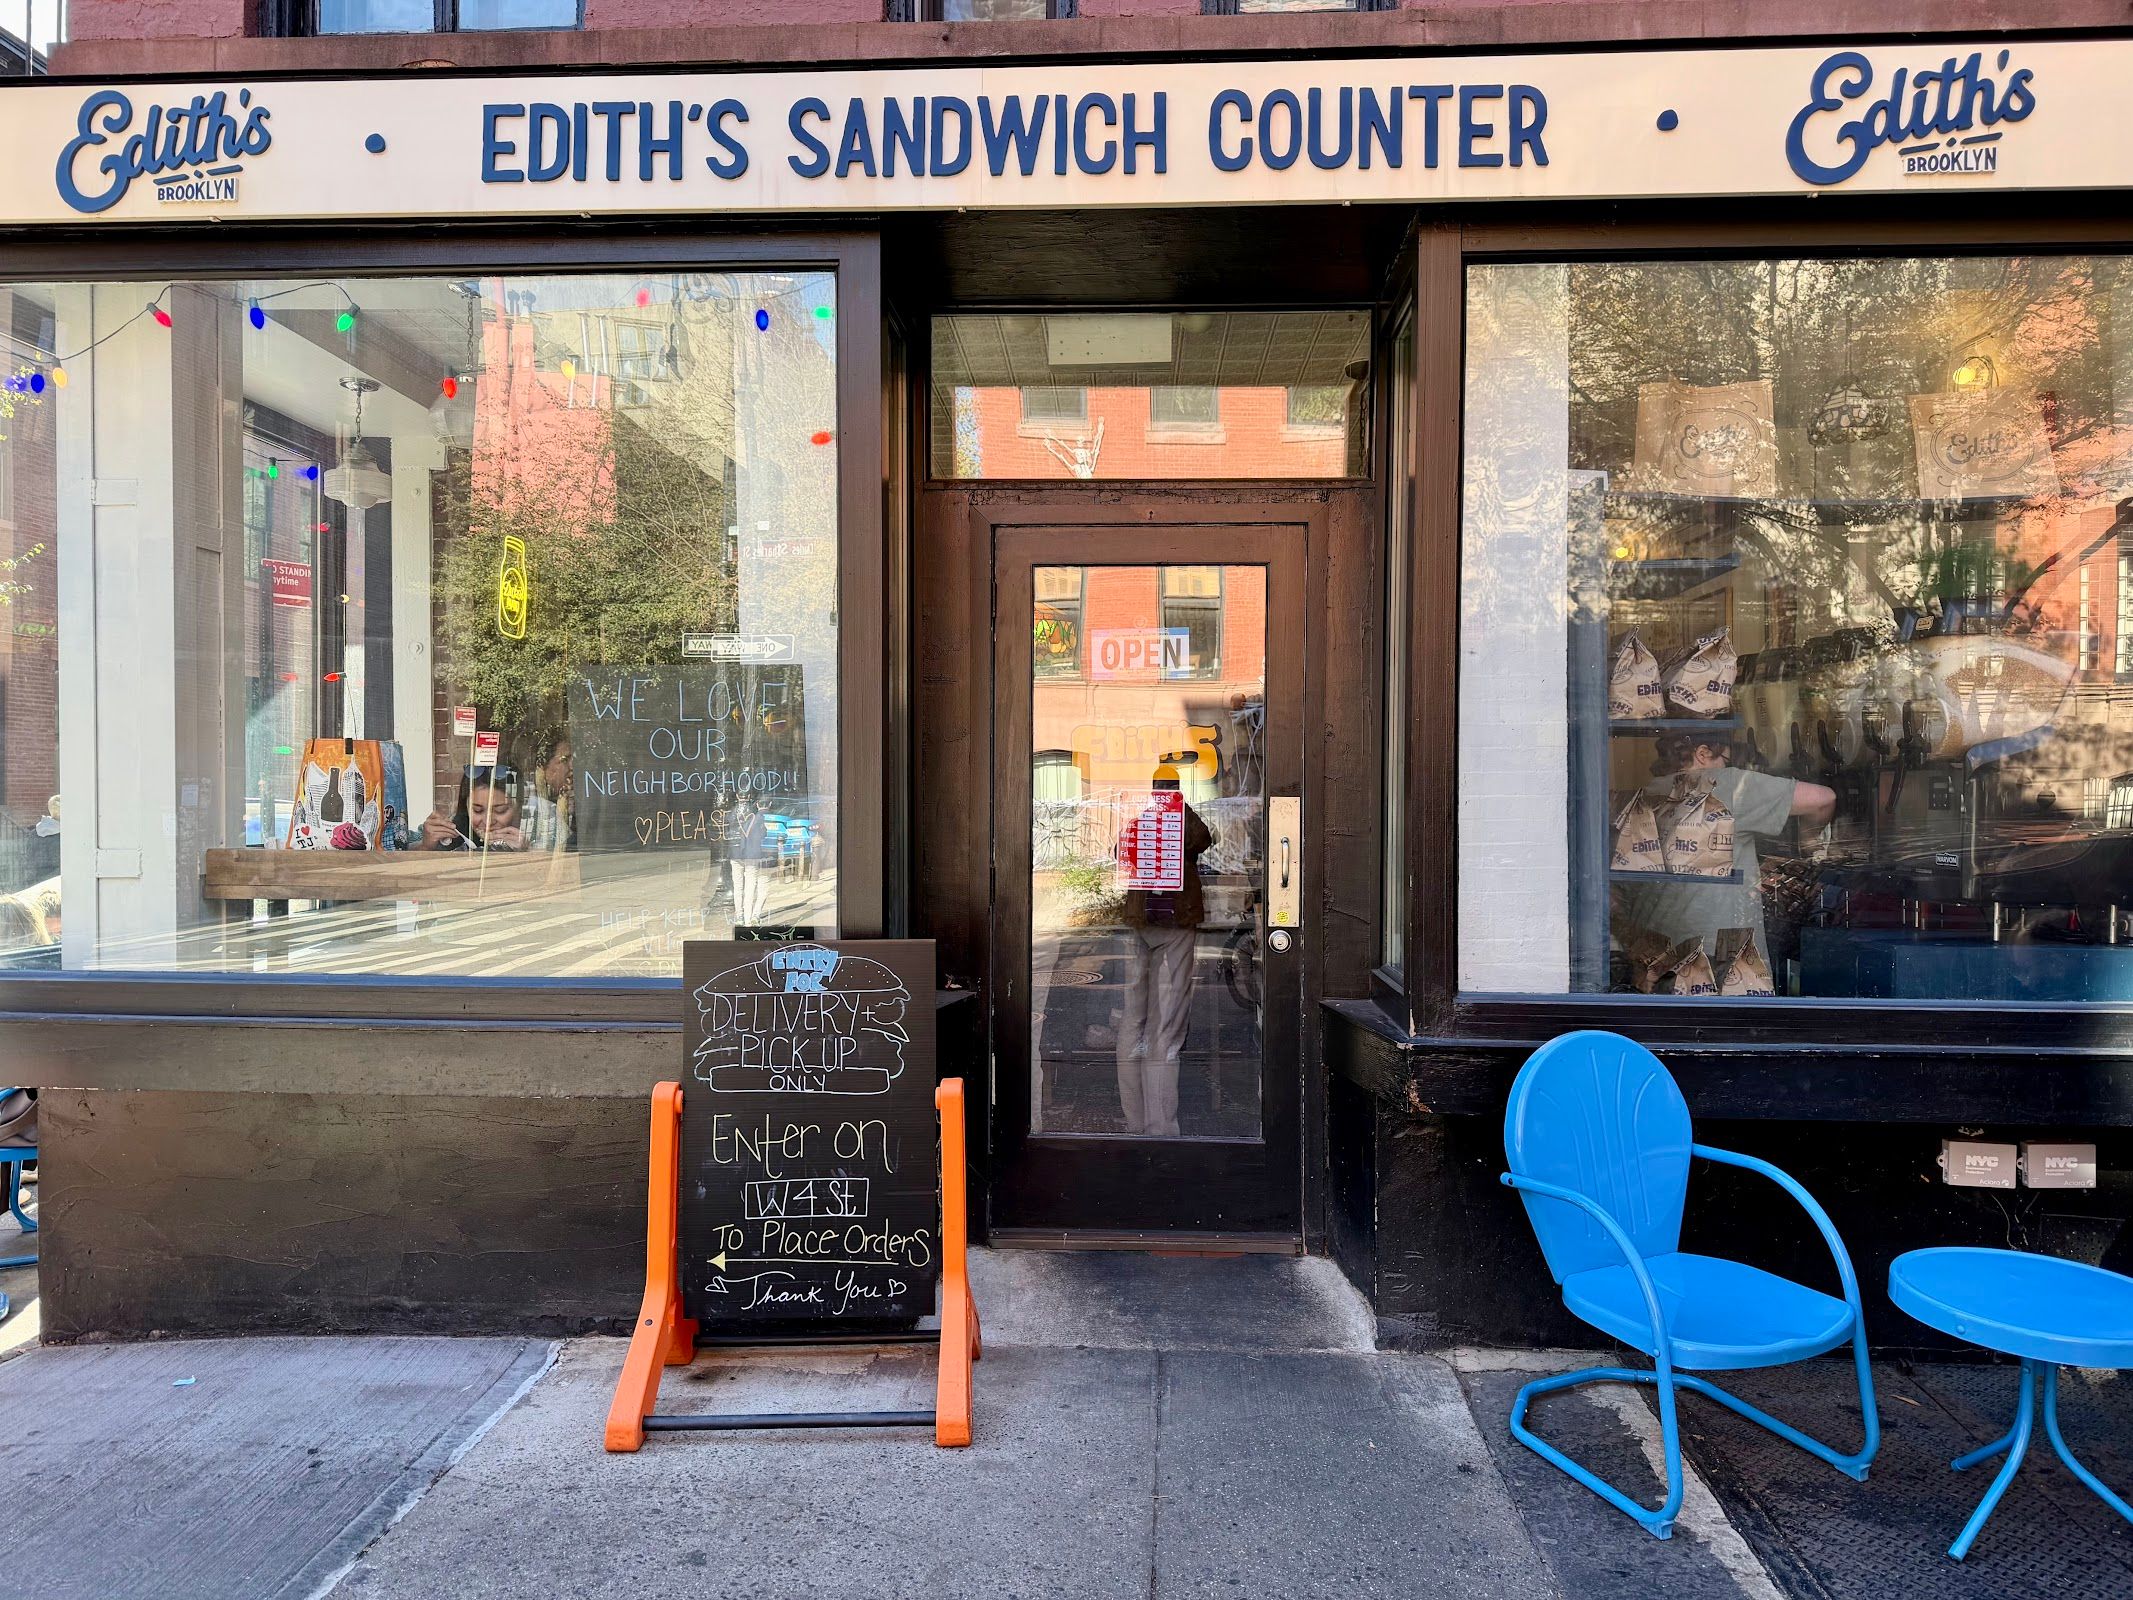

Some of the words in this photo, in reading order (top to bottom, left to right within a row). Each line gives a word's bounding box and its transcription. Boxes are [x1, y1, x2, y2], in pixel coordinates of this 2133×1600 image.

[481, 100, 749, 183] EDITH'S
[788, 92, 1167, 179] SANDWICH
[1208, 84, 1549, 172] COUNTER
[1787, 51, 2036, 185] Edith's
[56, 90, 271, 213] Edith's
[1906, 147, 1997, 172] BROOKLYN
[157, 177, 236, 201] BROOKLYN
[1100, 637, 1182, 671] OPEN
[586, 678, 651, 722] WE
[679, 681, 788, 725] LOVE
[649, 727, 726, 762] OUR
[584, 769, 799, 798] NEIGHBORHOOD!!
[655, 809, 735, 844] PLEASE
[772, 950, 839, 976] ENTRY
[784, 971, 828, 993] FOR
[712, 993, 861, 1036] DELIVERY
[741, 1034, 812, 1074] PICK
[821, 1036, 858, 1073] UP
[769, 1074, 827, 1092] ONLY
[833, 1120, 893, 1174] on
[1965, 1155, 1999, 1168] NYC
[2045, 1156, 2079, 1169] NYC
[755, 1181, 790, 1217] W
[792, 1180, 818, 1217] 4
[825, 1180, 857, 1217] St
[762, 1220, 840, 1255] Place
[843, 1218, 931, 1267] Orders
[722, 1270, 825, 1310] Thank
[832, 1269, 883, 1315] You
